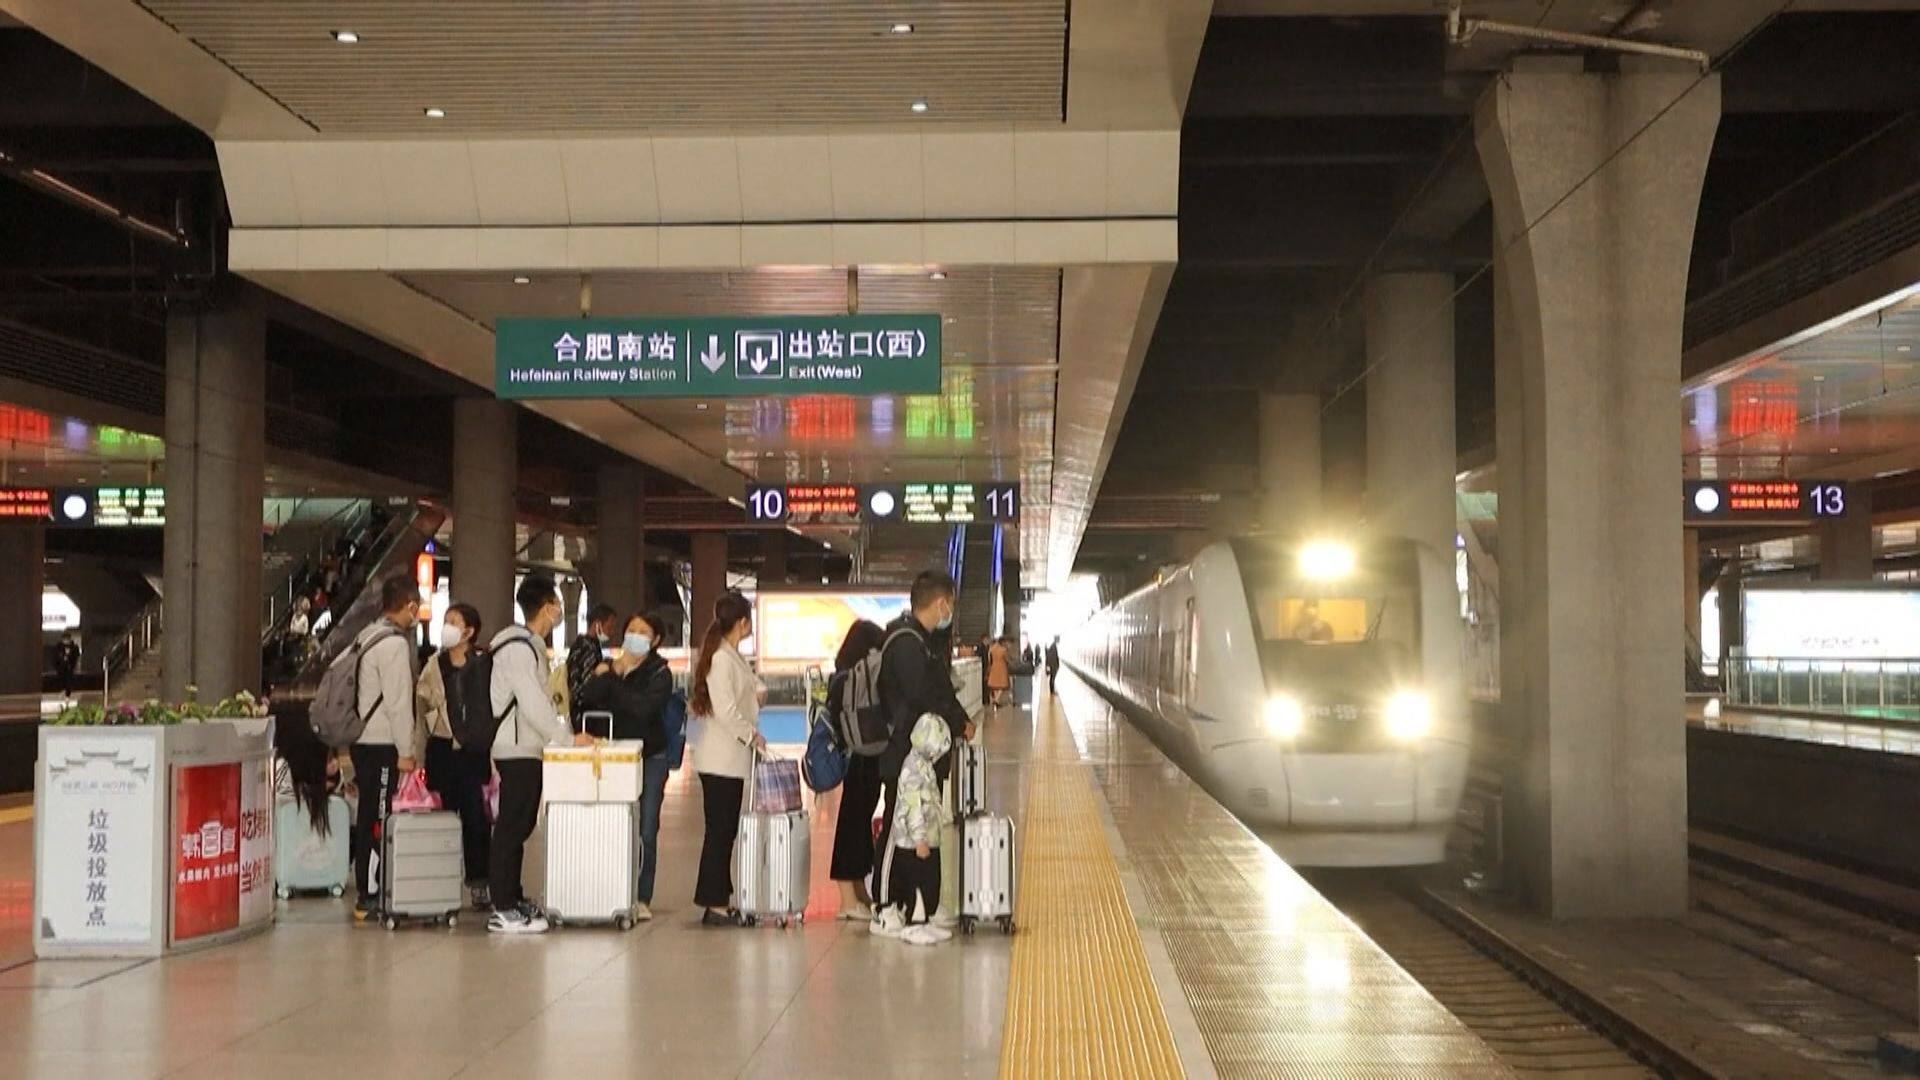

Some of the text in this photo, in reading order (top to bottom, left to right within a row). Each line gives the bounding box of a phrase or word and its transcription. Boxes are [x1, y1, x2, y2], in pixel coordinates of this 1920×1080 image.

[554, 332, 676, 361] 合肥南站
[789, 329, 926, 359] 出站口(西)
[510, 367, 676, 383] Hefeinan Railway Station
[789, 364, 862, 380] Exit(West)
[749, 489, 783, 519] 10
[985, 488, 1014, 517] 11
[1809, 485, 1844, 515] 13
[86, 808, 110, 928] 垃圾投放点
